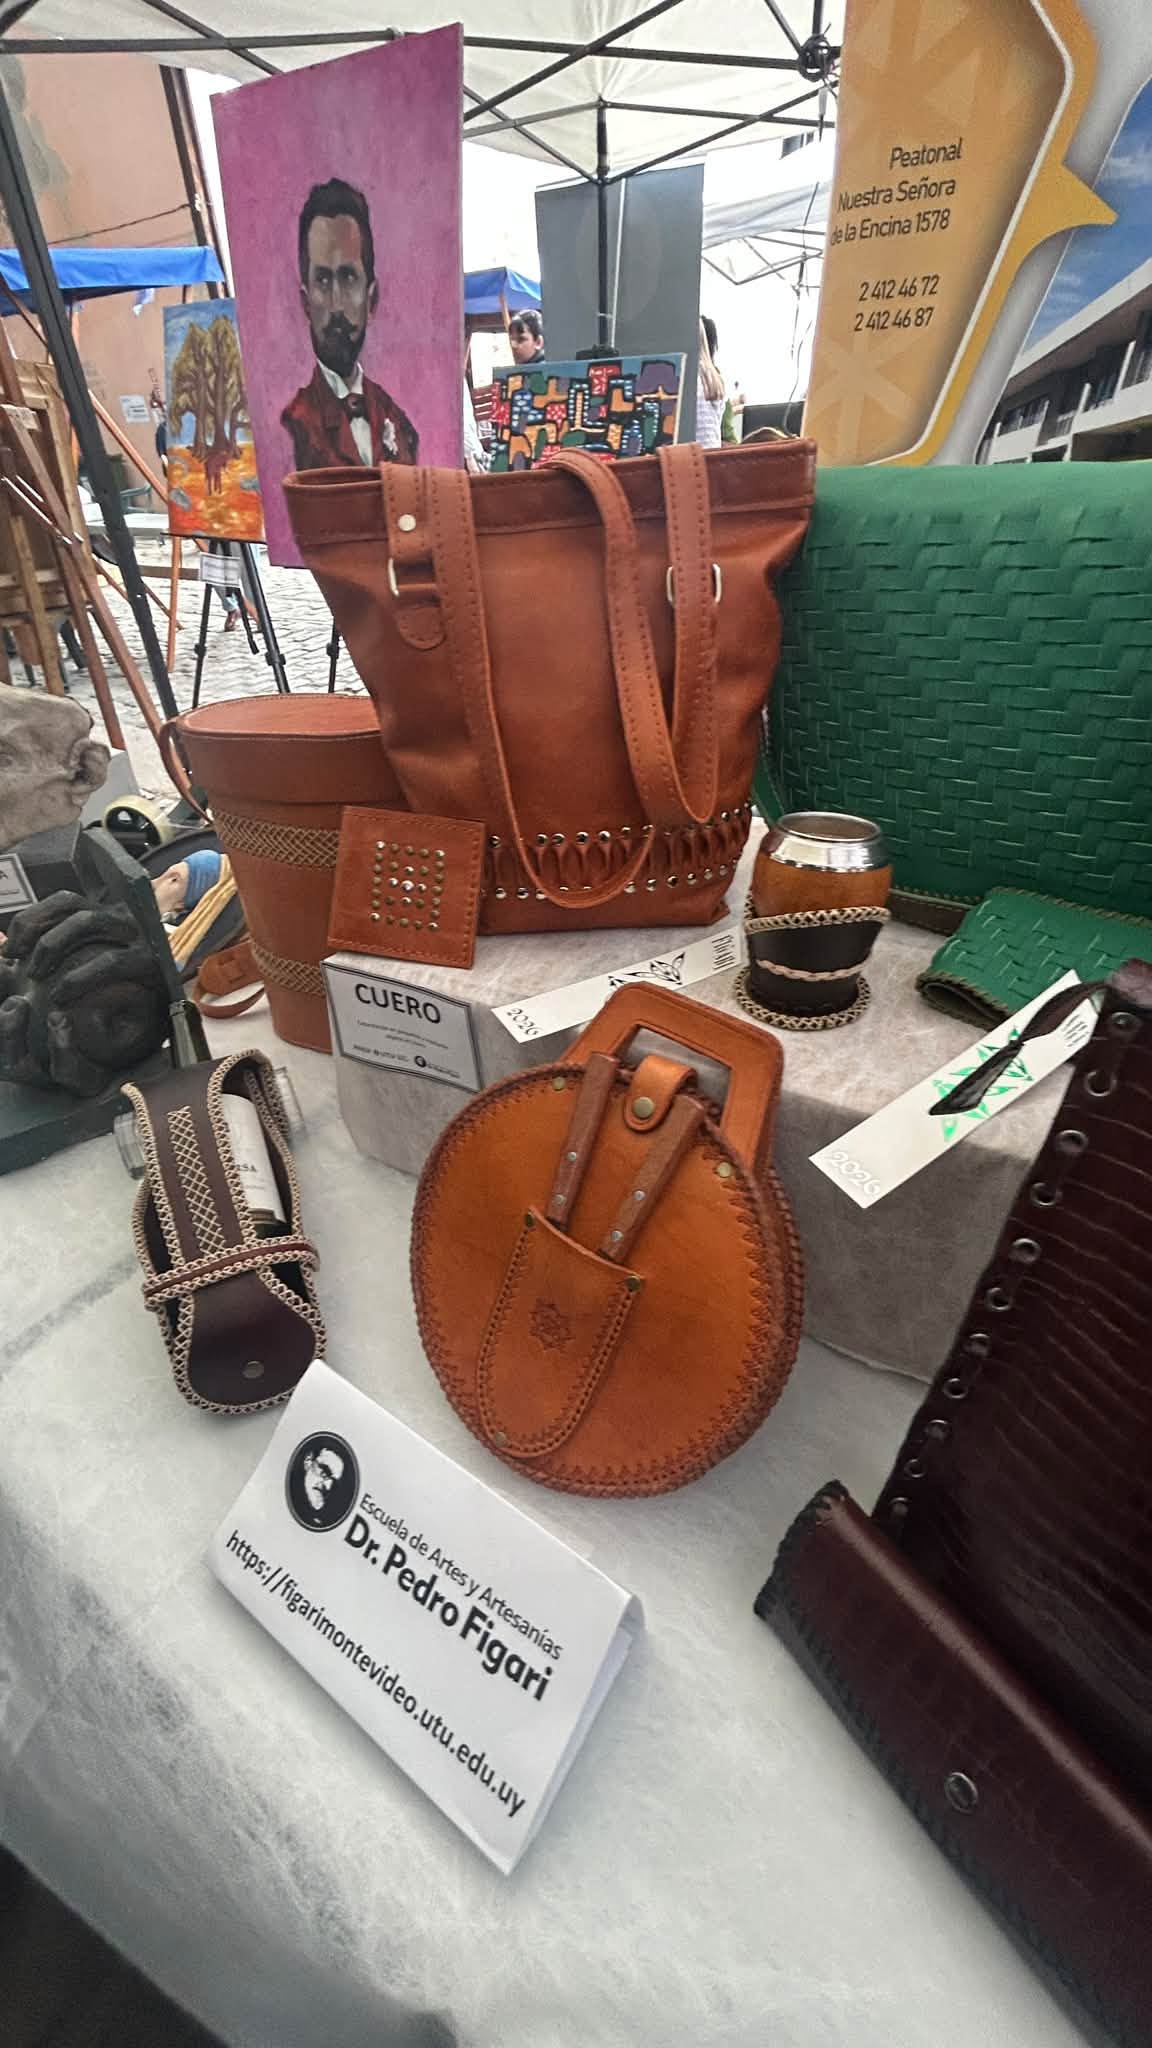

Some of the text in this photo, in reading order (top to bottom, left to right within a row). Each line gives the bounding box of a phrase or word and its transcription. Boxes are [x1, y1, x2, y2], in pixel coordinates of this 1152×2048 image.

[889, 137, 963, 170] Peatonal
[837, 176, 956, 213] Nuestra Señora
[830, 208, 951, 246] de la Encina 1578
[859, 274, 940, 302] 2 412 46 72
[854, 307, 935, 332] 2 412 46 87
[354, 982, 442, 1025] CUERO
[506, 1007, 543, 1036] 2026
[826, 1150, 881, 1196] 2026
[359, 1493, 563, 1660] Escuela de Artes y Artesanías
[343, 1513, 553, 1701] Dr. Pedro Figari
[225, 1528, 527, 1818] https://figarimontevideo.utu.edu.uy
